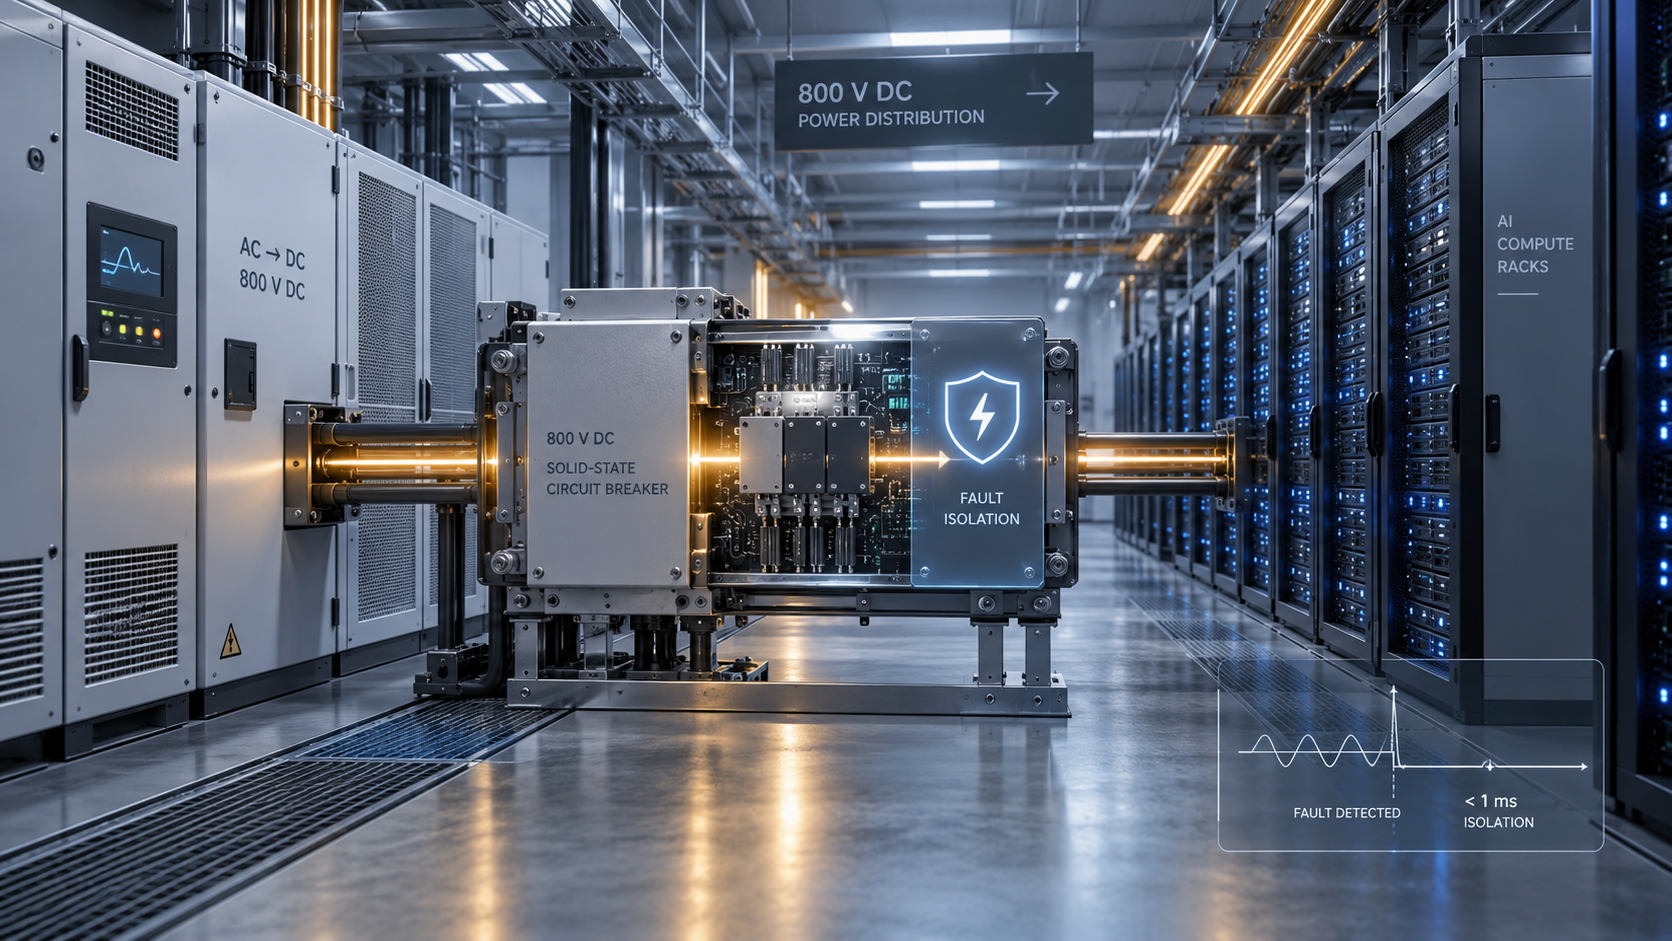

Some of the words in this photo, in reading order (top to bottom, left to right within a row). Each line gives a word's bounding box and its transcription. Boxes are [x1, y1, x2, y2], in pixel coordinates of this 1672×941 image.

[798, 81, 844, 104] 800
[850, 81, 869, 103] V
[876, 80, 913, 102] DC
[798, 112, 860, 128] POWER
[865, 109, 986, 127] DISTRIBUTION
[1497, 214, 1513, 228] AI
[1497, 236, 1574, 251] COMPUTE
[239, 236, 261, 259] AC
[285, 248, 306, 270] DC
[1497, 259, 1549, 274] RACKS
[239, 269, 267, 292] 800
[271, 276, 282, 296] V
[285, 279, 306, 301] DC
[546, 431, 574, 445] 800
[578, 431, 590, 445] V
[593, 431, 615, 445] DC
[546, 461, 636, 475] SOLID-STATE
[546, 482, 602, 496] CIRCUIT
[605, 482, 669, 496] BREAKER
[960, 491, 1005, 505] FAULT
[944, 512, 1020, 526] ISOLATION
